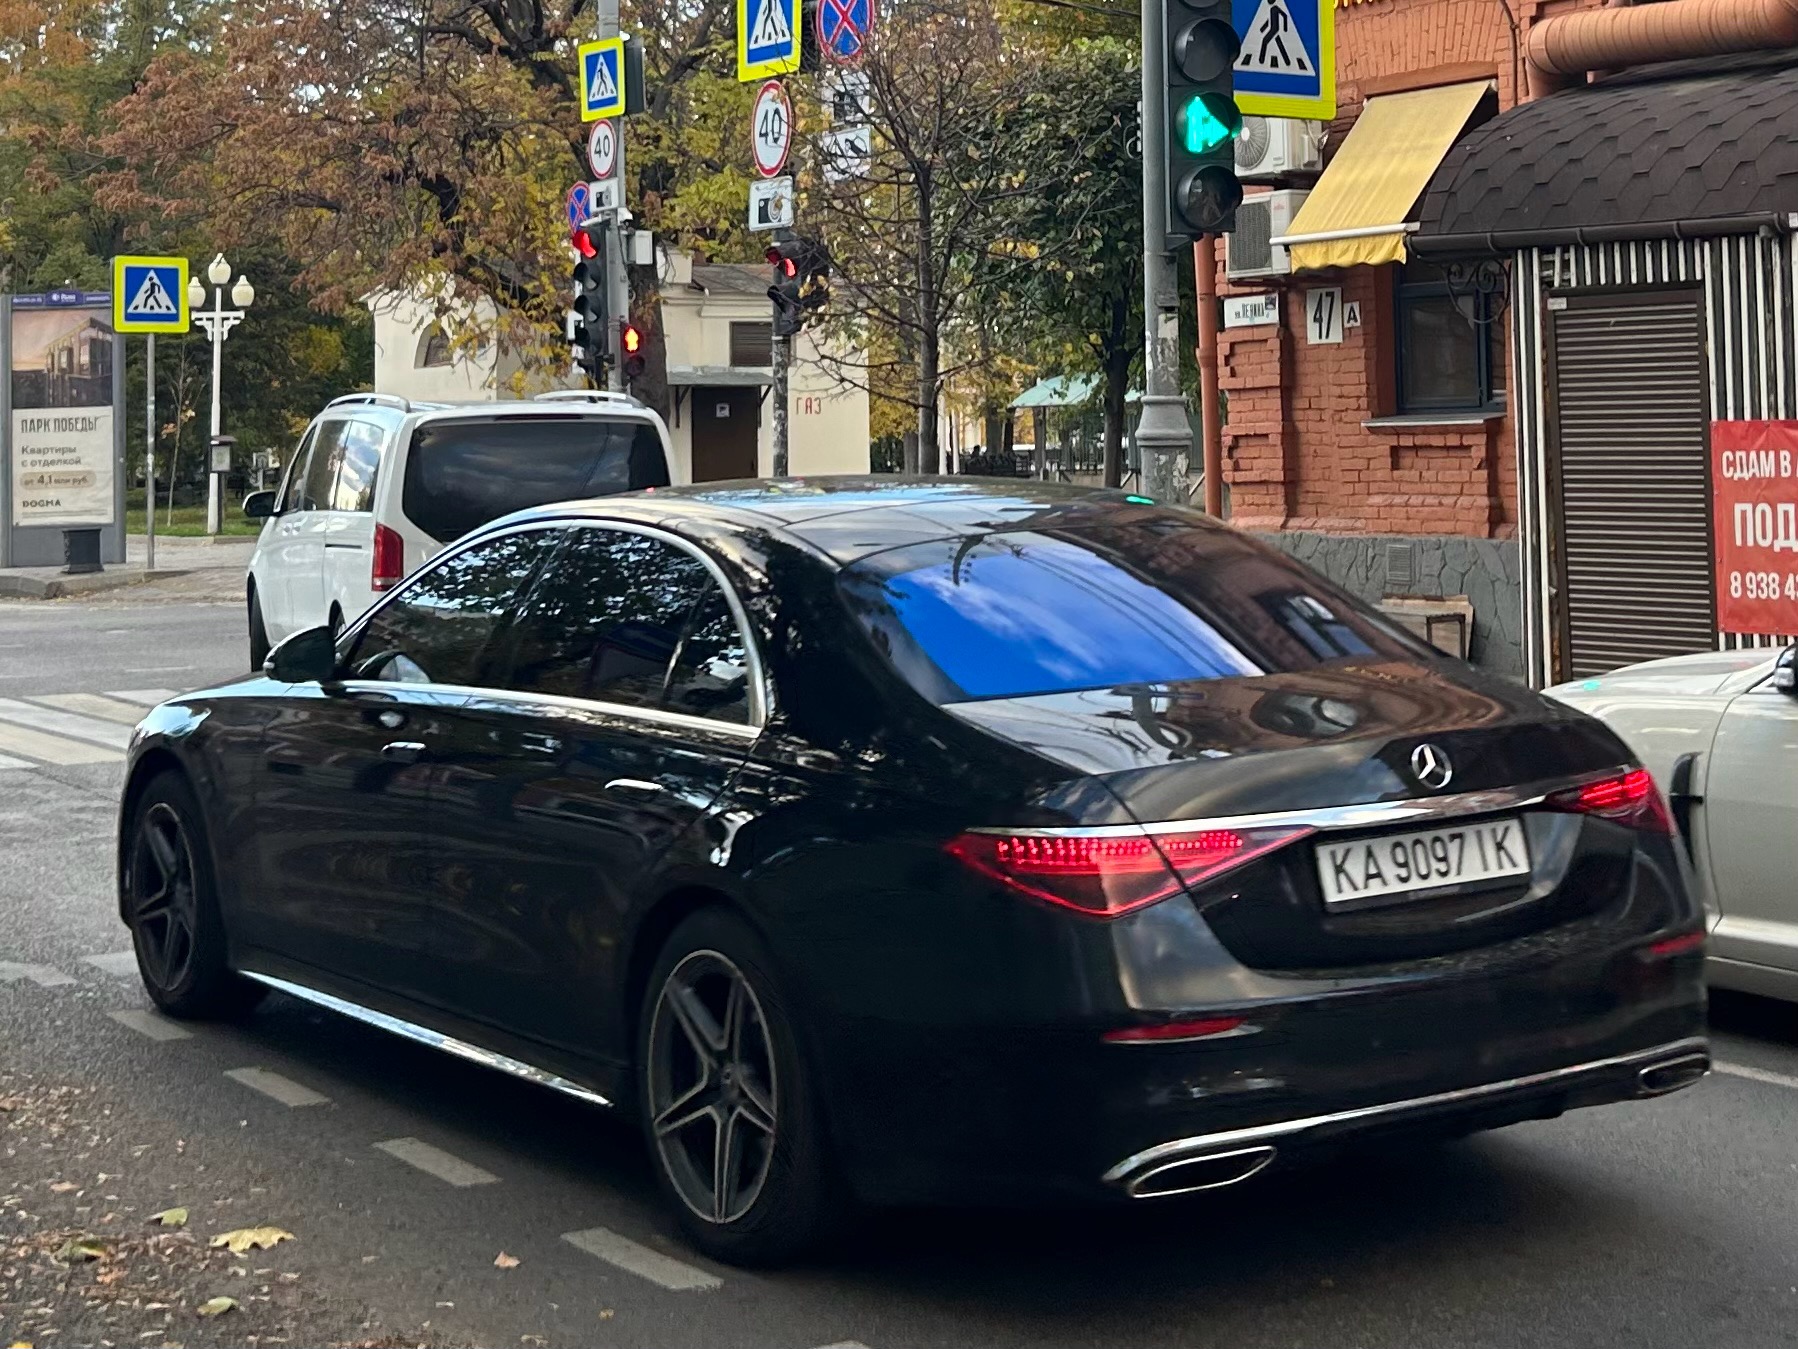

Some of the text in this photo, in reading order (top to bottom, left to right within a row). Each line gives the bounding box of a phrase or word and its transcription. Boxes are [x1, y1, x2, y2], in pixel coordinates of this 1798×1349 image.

[759, 107, 781, 143] 40
[594, 135, 611, 157] 40
[1313, 291, 1335, 340] 47
[1347, 305, 1359, 324] А
[796, 397, 822, 415] ГАЗ
[21, 416, 100, 433] ПАРК ПОБЕДЫ
[21, 445, 77, 455] Квартиры
[30, 456, 82, 467] отделкой
[1722, 450, 1776, 481] СДАМ
[1780, 450, 1792, 478] В
[22, 499, 62, 508] DOGMA
[1730, 570, 1742, 598] 8
[1745, 571, 1781, 600] 938
